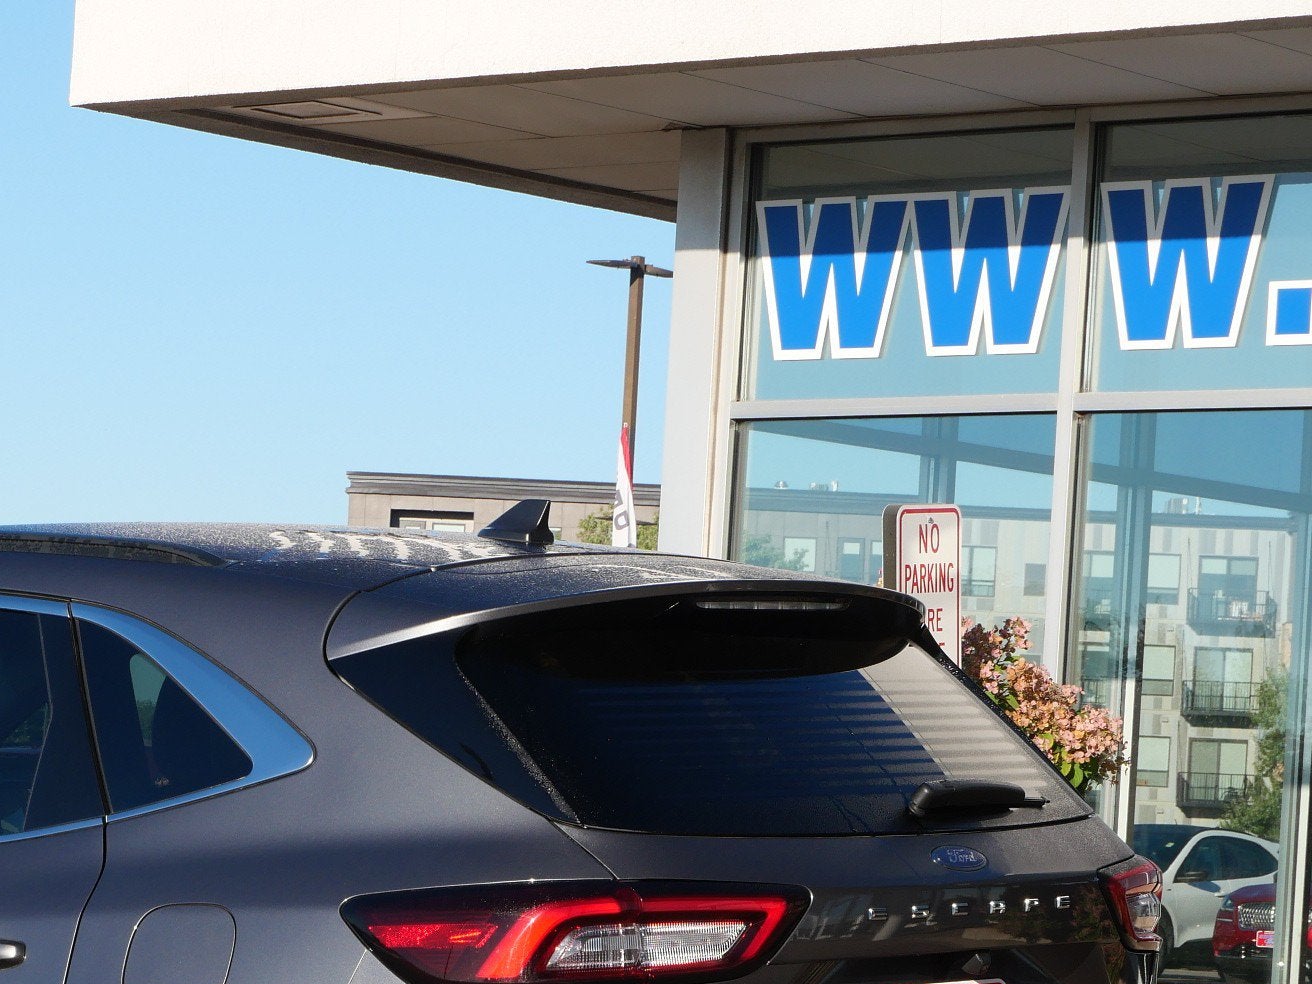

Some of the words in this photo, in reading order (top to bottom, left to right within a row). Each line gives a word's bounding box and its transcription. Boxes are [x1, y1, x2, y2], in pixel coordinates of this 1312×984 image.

[918, 523, 940, 554] NO
[904, 562, 954, 594] PARKING
[946, 848, 978, 863] Ford
[867, 895, 1071, 921] ESCAPE
